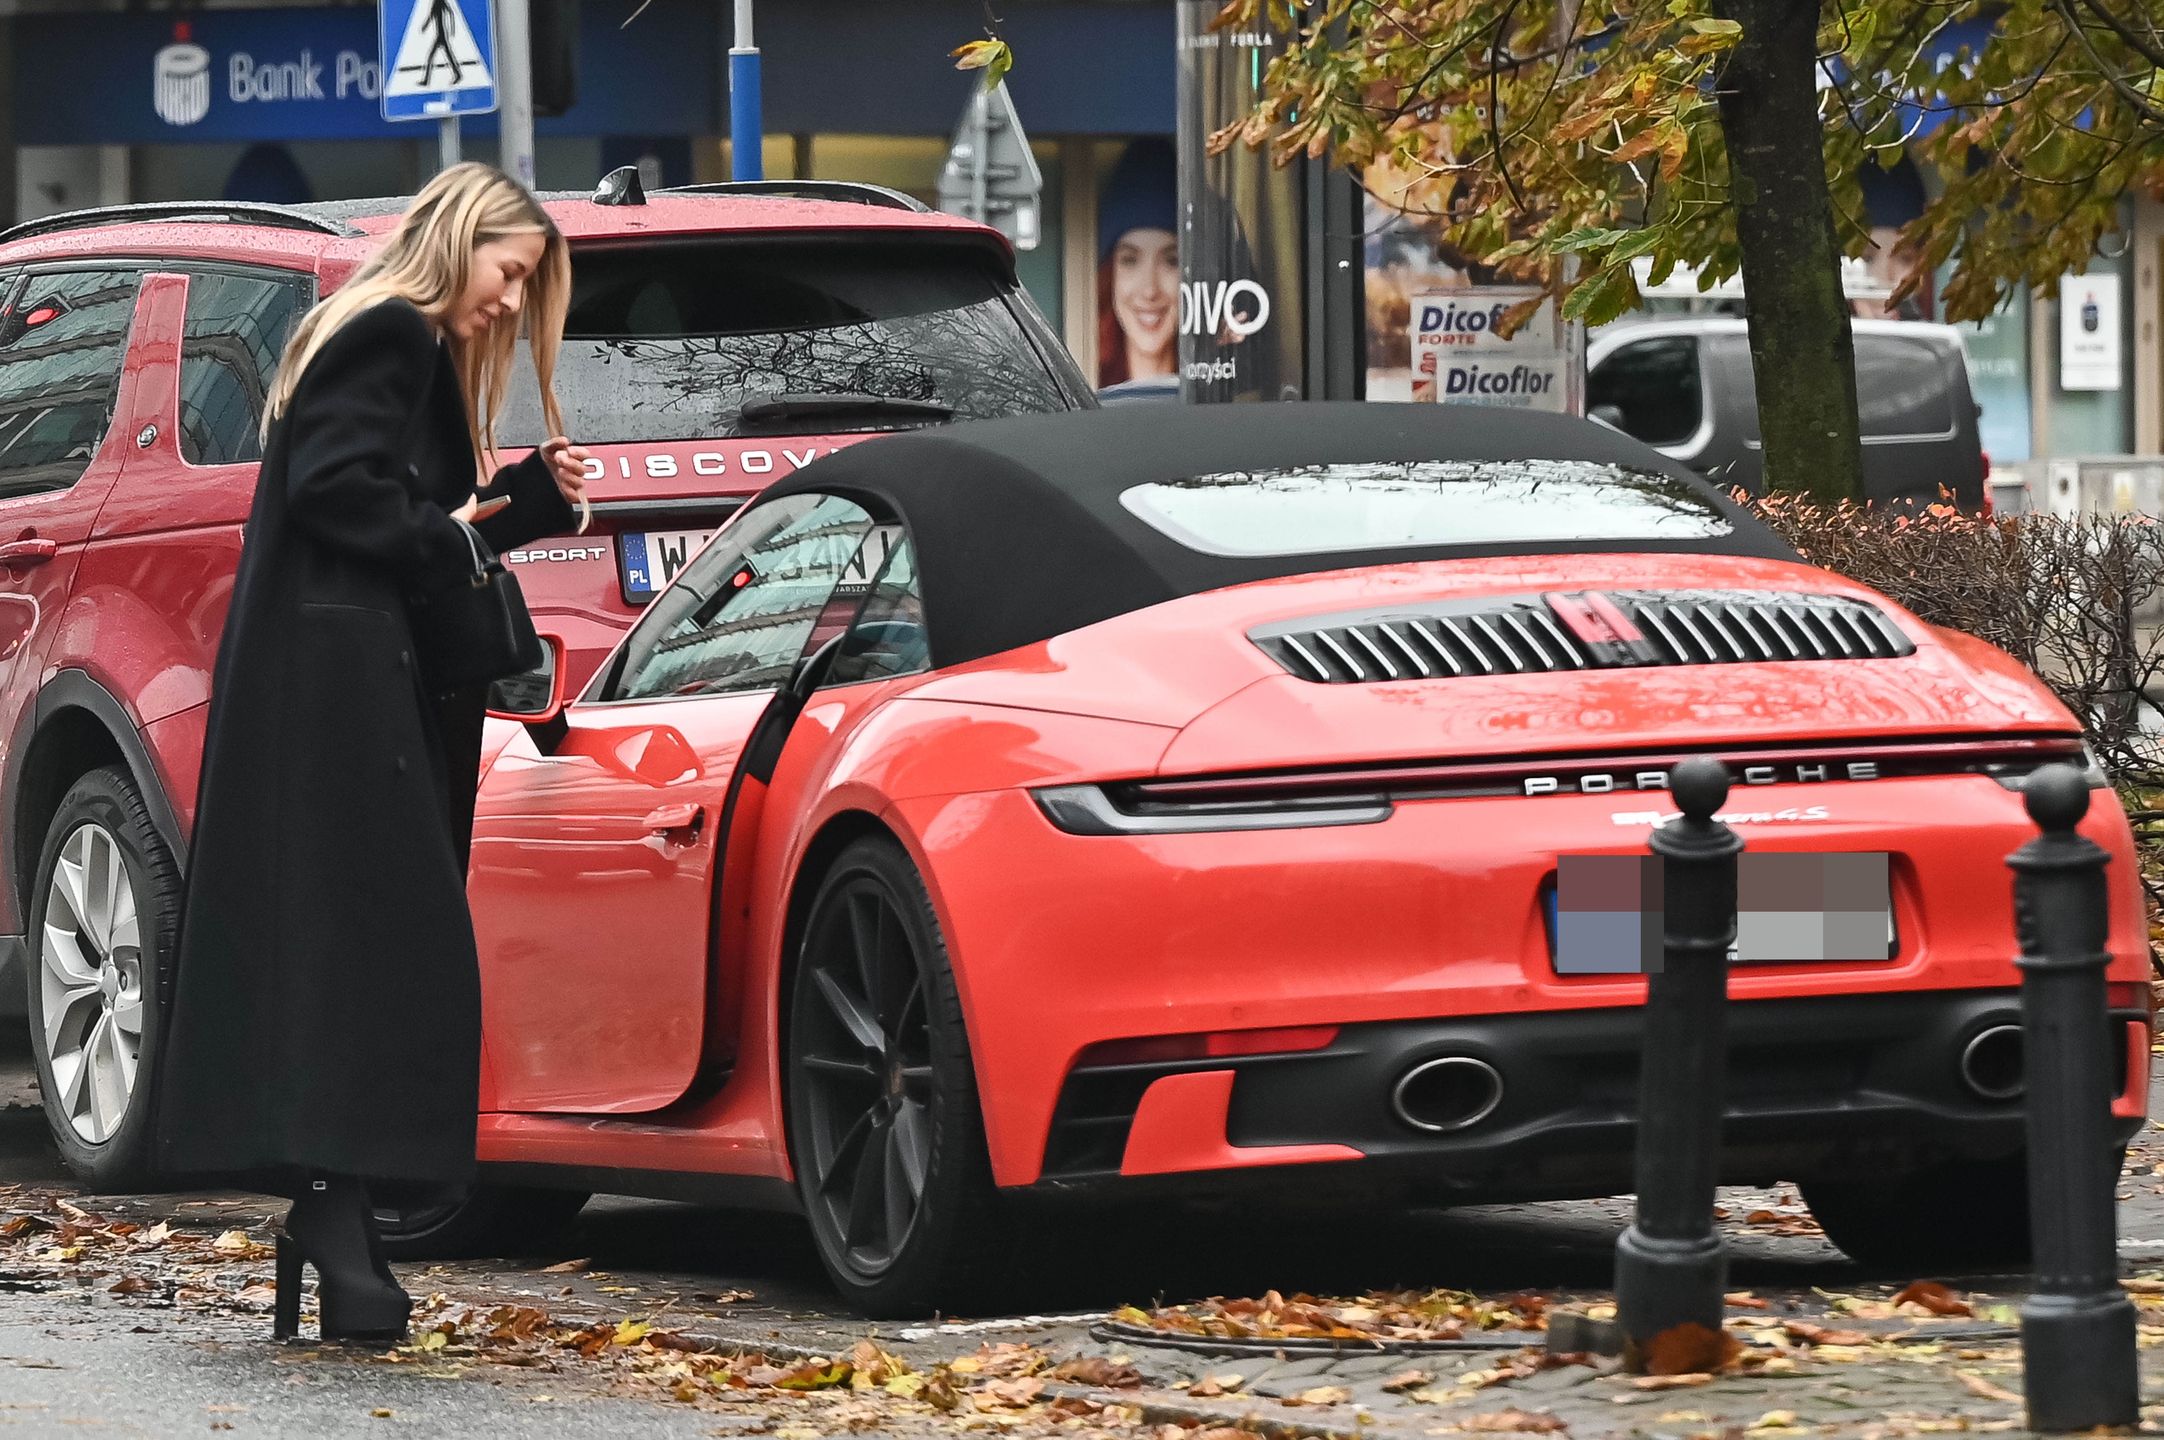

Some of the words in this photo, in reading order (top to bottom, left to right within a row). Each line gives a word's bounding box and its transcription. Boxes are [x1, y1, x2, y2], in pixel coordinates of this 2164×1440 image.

[229, 50, 324, 102] Bank
[1419, 302, 1530, 333] Dicof
[1418, 333, 1476, 345] FORTE
[1446, 364, 1554, 394] Dicoflor
[581, 448, 840, 480] DISCOV
[508, 547, 606, 564] SPORT
[629, 569, 648, 585] PL
[1524, 762, 1878, 796] PORCHE
